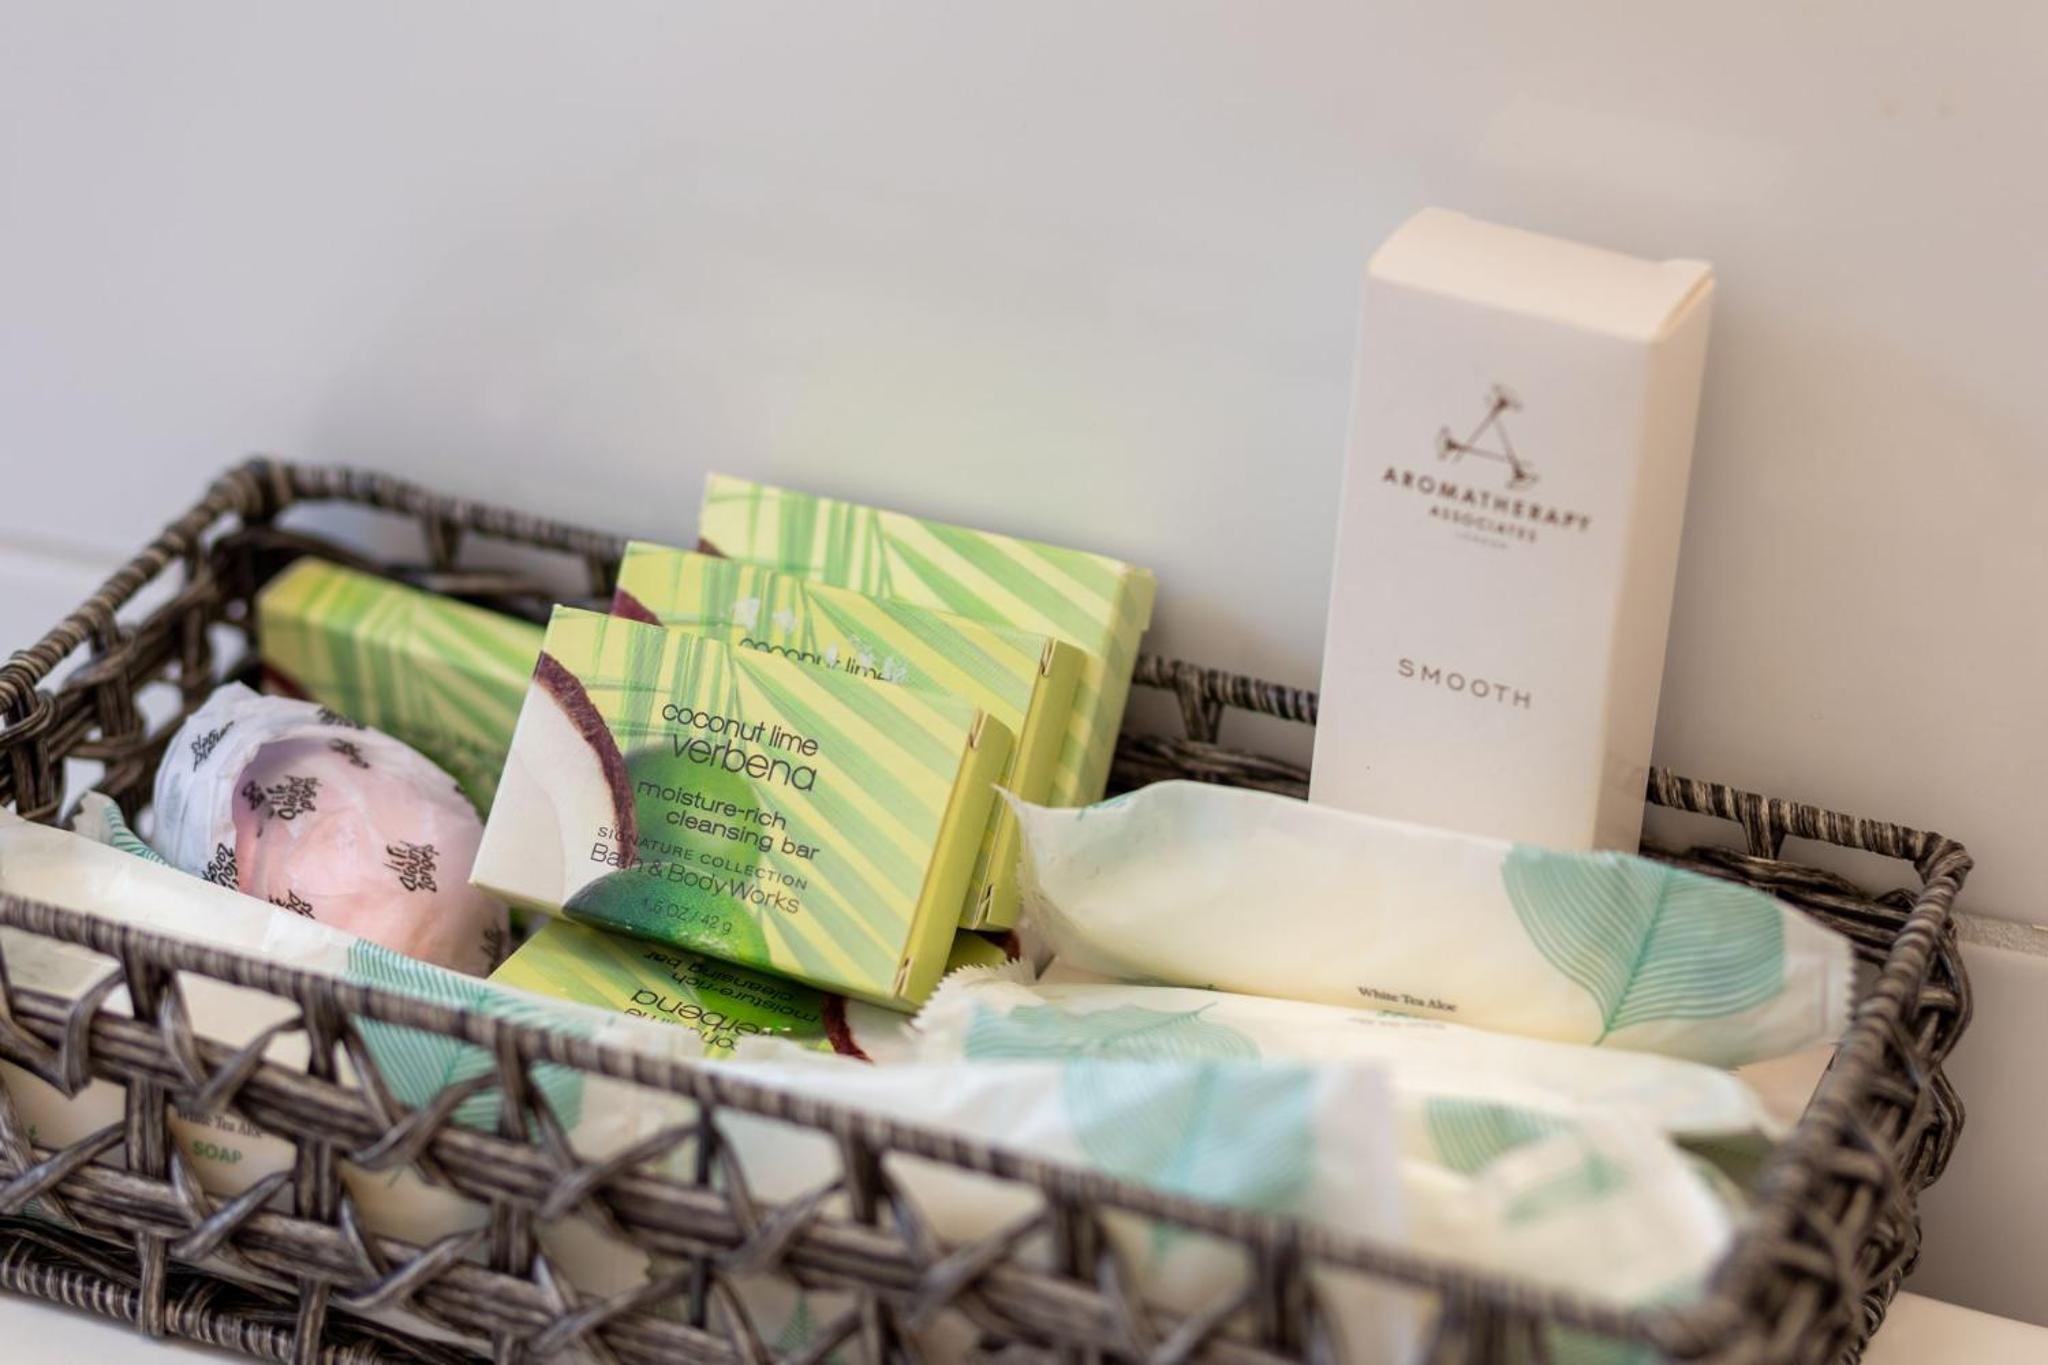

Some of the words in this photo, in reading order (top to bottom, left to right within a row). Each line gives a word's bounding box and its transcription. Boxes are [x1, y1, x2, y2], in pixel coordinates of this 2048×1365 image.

[1382, 466, 1592, 532] AROMATHERAPY
[1429, 504, 1537, 543] ASSOCIATES
[1398, 657, 1532, 710] SMOOTH
[662, 703, 766, 744] coconut
[768, 724, 819, 757] lime
[673, 733, 818, 791] verbena
[636, 781, 787, 830] moisture-rich
[666, 809, 774, 852] cleansing
[780, 837, 821, 860] bar
[648, 860, 663, 879] &
[699, 853, 809, 890] COLLECTION
[701, 912, 720, 930] 42
[722, 921, 733, 936] g
[643, 950, 684, 971] bar
[687, 959, 794, 1001] cleansing
[671, 971, 820, 1024] moisture-rich
[1356, 986, 1399, 1003] White
[1401, 993, 1425, 1008] Tea
[1427, 998, 1458, 1013] Aloe
[191, 1140, 243, 1165] SOAP
